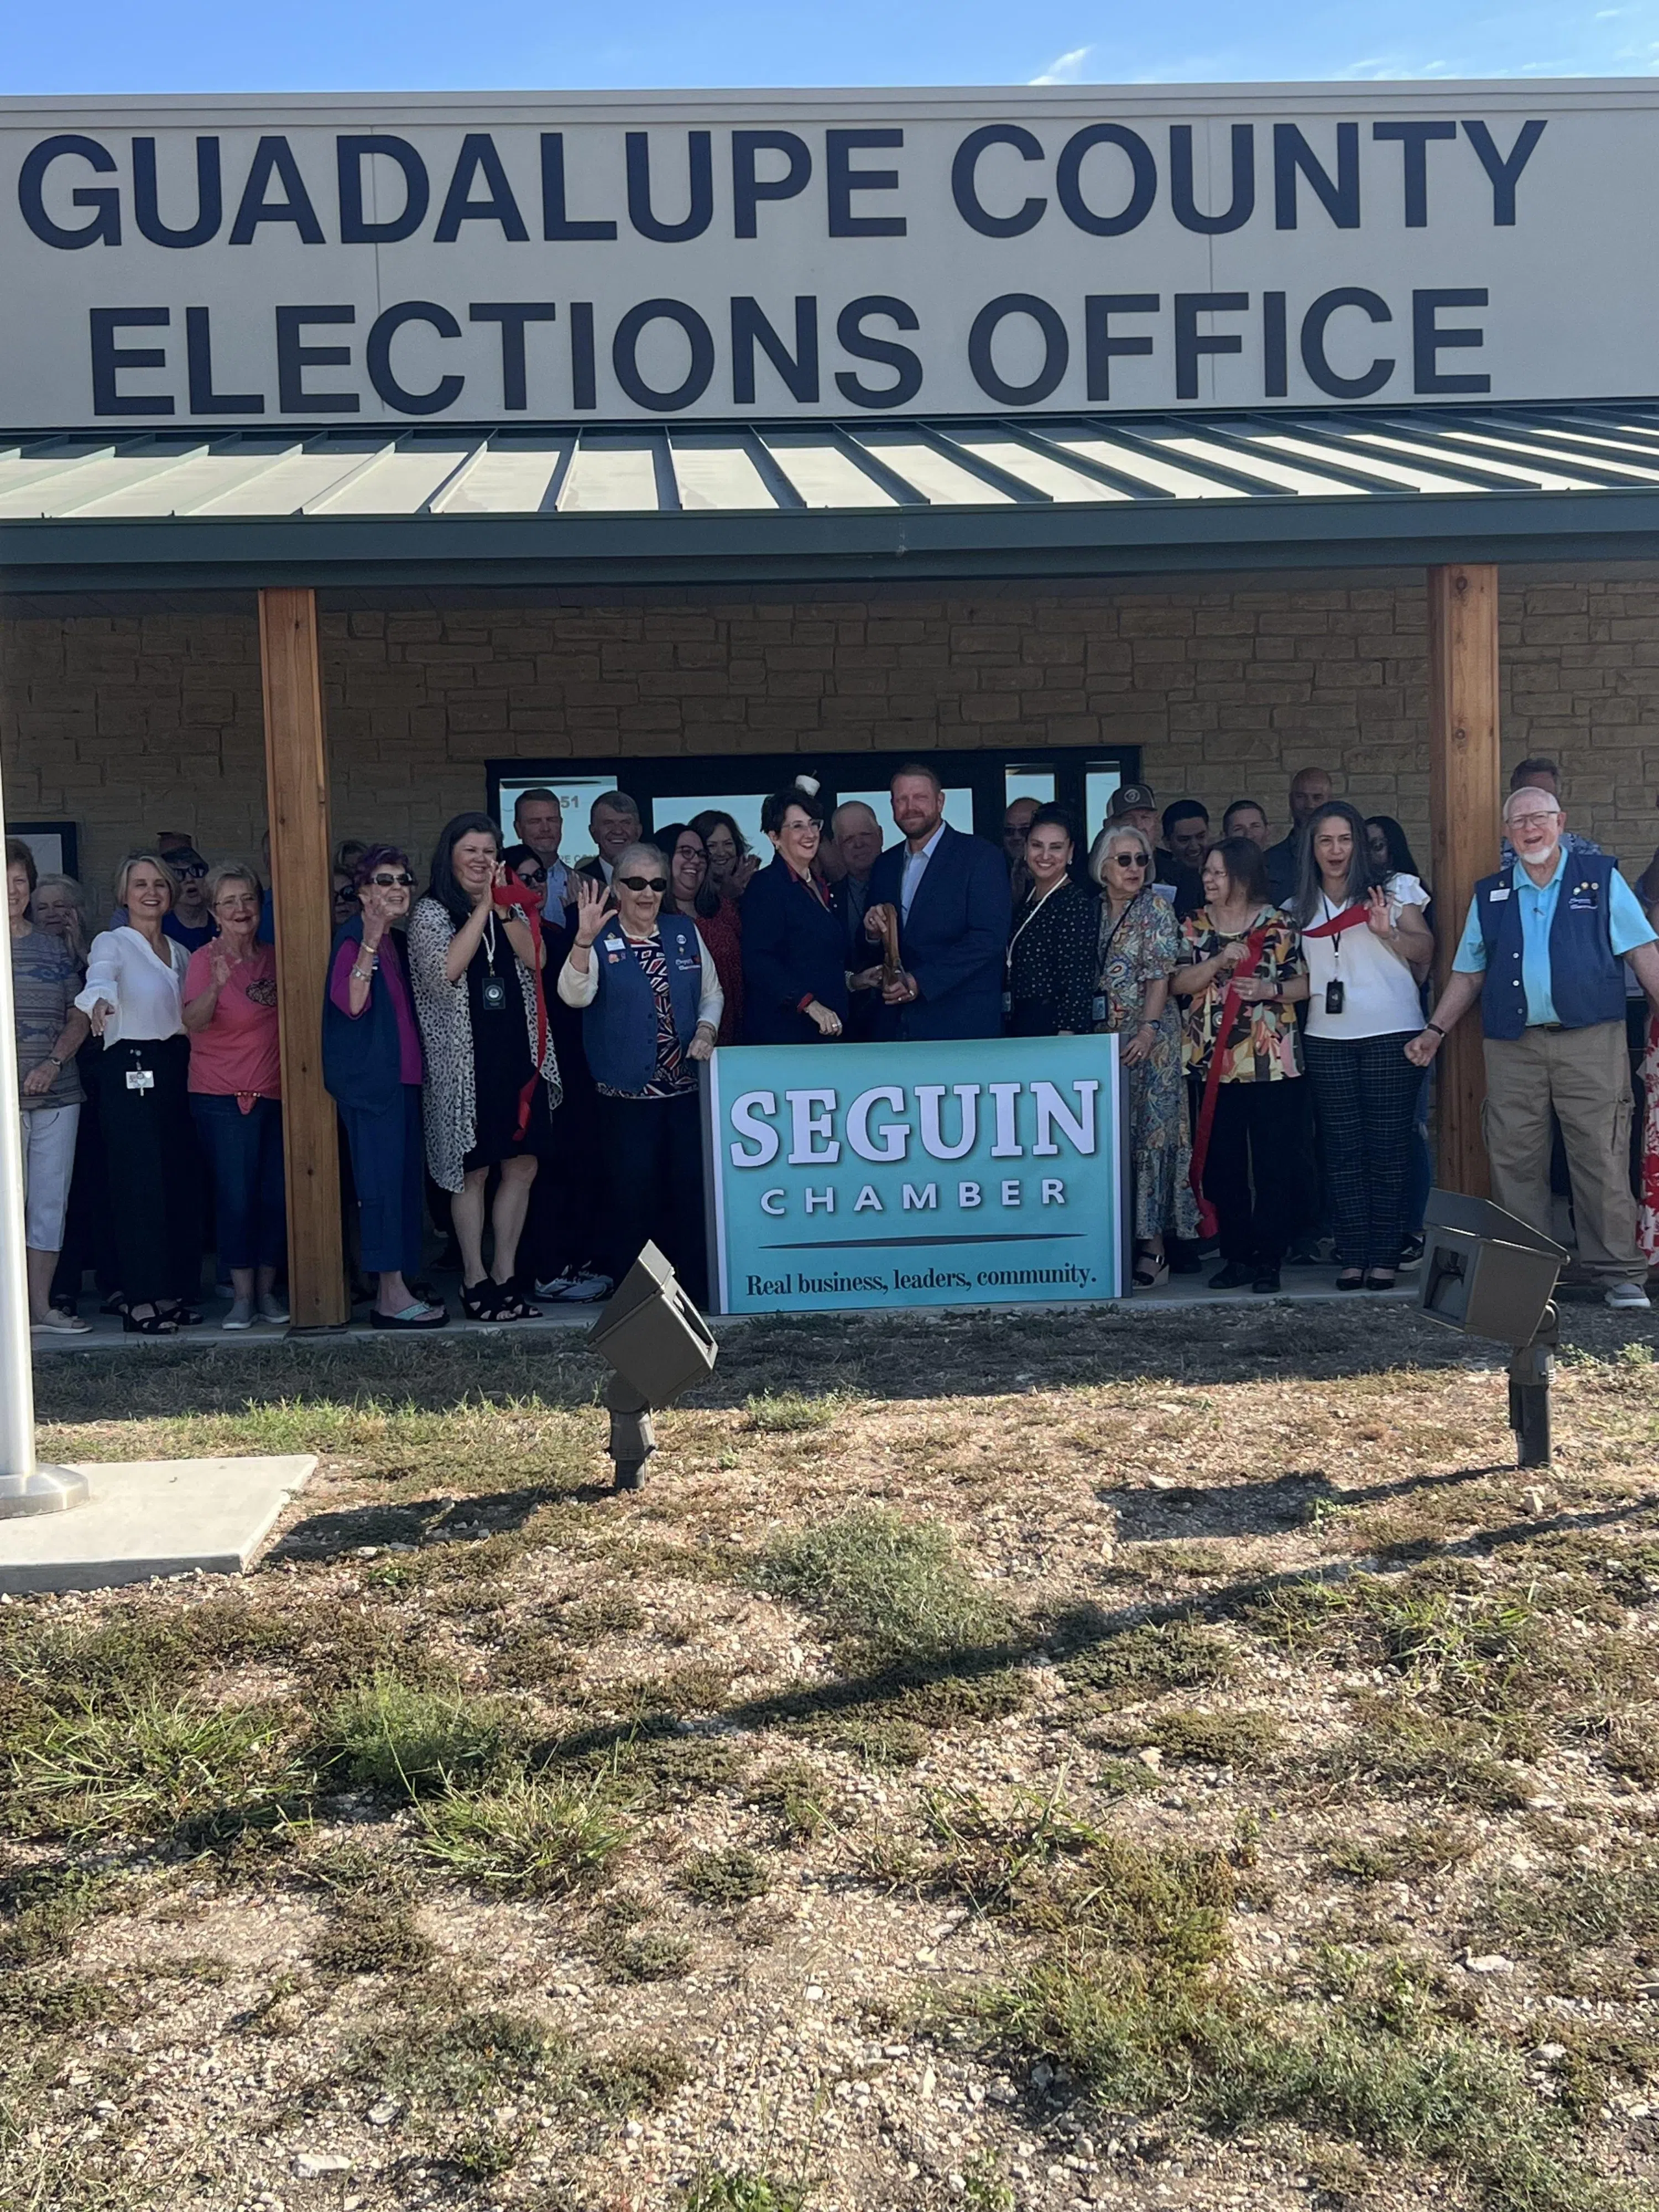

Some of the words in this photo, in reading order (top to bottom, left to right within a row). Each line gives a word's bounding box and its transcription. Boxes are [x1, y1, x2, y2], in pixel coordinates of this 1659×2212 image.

[18, 130, 907, 251] GUADALUPE
[951, 119, 1549, 239] COUNTY
[89, 295, 924, 419] ELECTIONS
[968, 286, 1491, 406] OFFICE
[729, 1079, 1100, 1168] SEGUIN
[760, 1178, 1066, 1215] CHAMBER
[745, 1273, 792, 1296] Real
[797, 1271, 889, 1295] business,
[893, 1269, 972, 1292] leaders,
[977, 1262, 1097, 1289] community.
